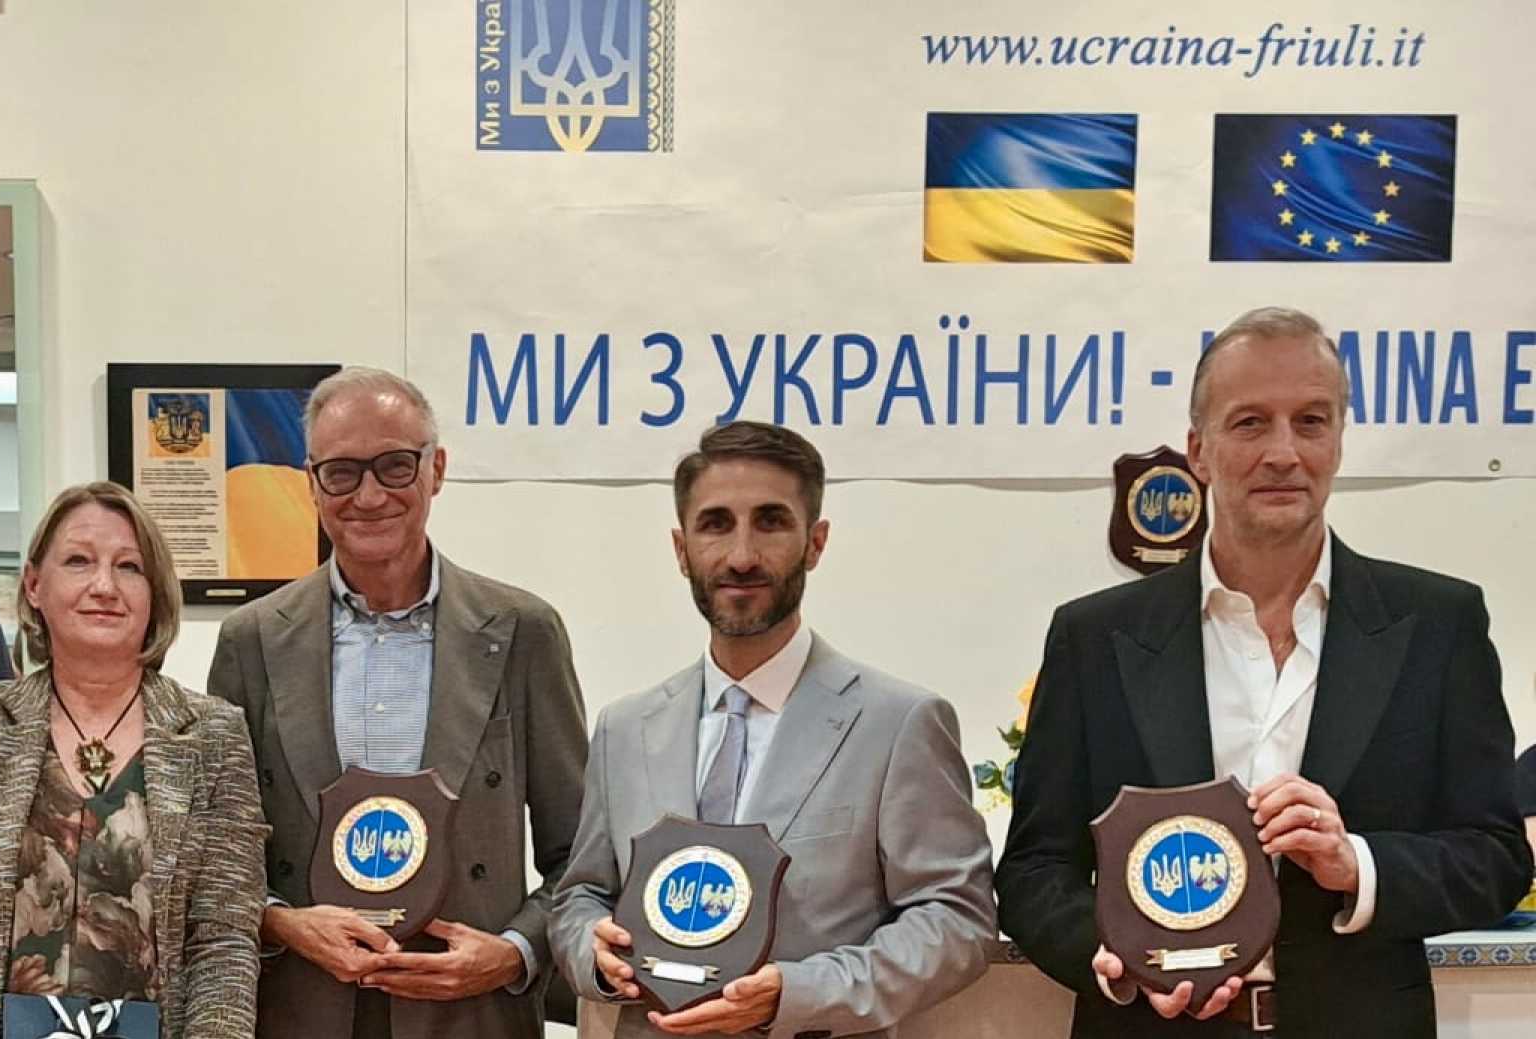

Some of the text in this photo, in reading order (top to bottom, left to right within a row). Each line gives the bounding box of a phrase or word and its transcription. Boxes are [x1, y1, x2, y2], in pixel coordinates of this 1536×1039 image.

[479, 0, 505, 72] Укра
[921, 23, 1427, 78] www.ucraina-friuli.it
[479, 102, 501, 145] Ми
[465, 332, 611, 426] МИ
[640, 331, 685, 427] З
[711, 314, 1126, 427] УКРАЇНИ!
